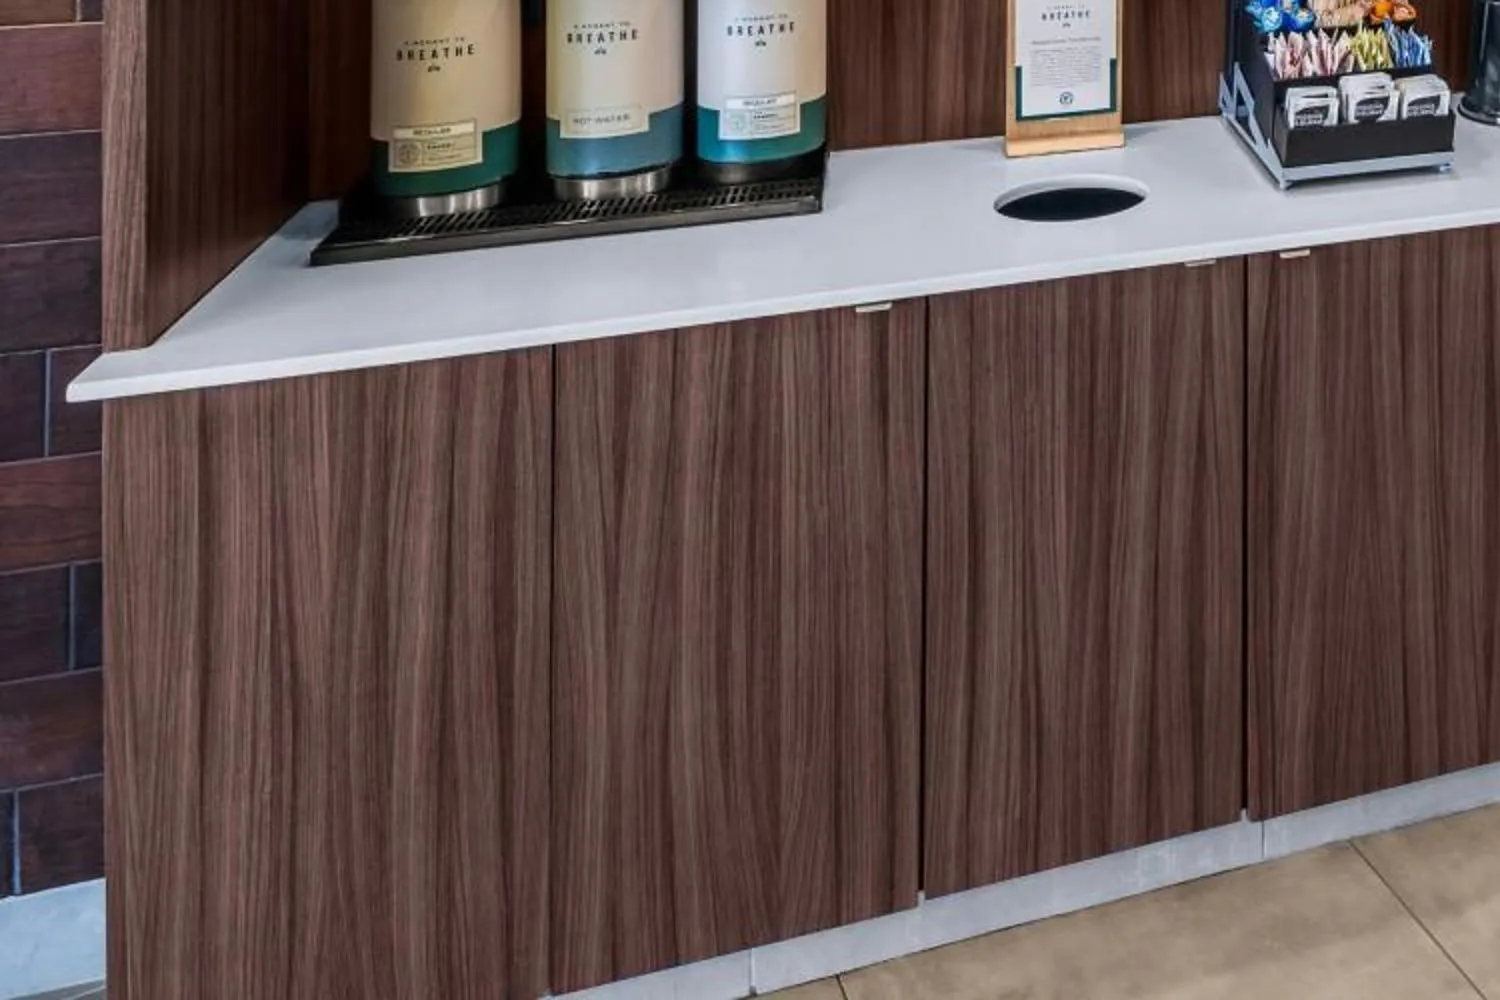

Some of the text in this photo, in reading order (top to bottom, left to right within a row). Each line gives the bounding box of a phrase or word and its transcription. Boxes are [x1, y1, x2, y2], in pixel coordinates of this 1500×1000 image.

[566, 29, 640, 45] BREATHE
[727, 21, 795, 37] BREATHE
[396, 43, 476, 62] BREATHE
